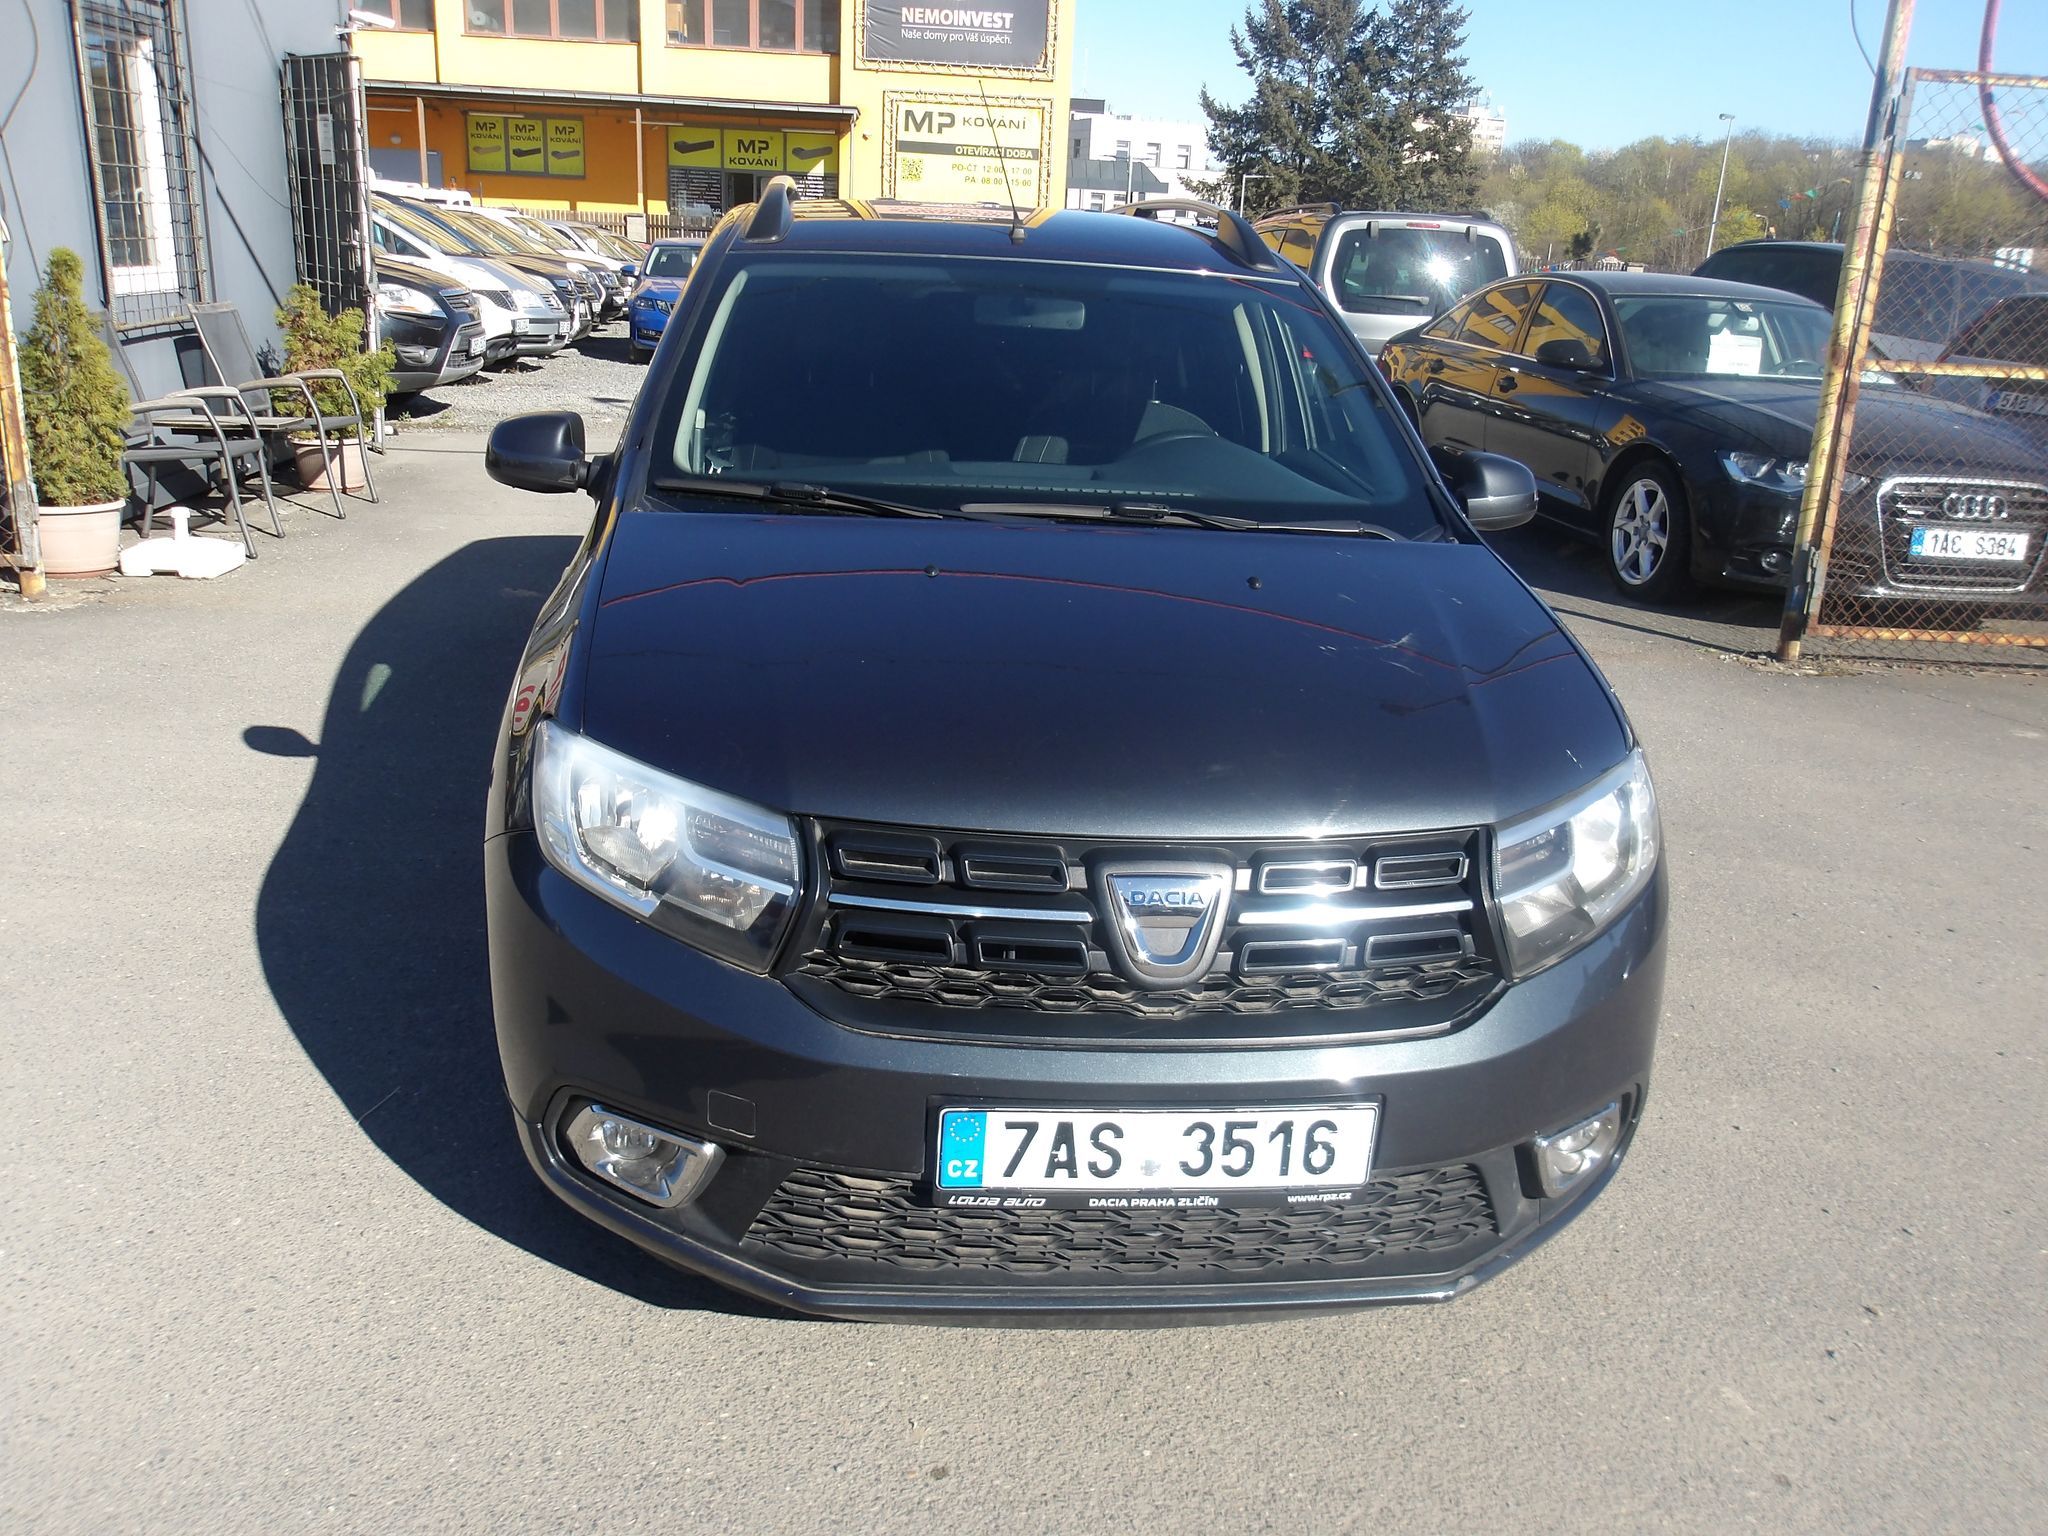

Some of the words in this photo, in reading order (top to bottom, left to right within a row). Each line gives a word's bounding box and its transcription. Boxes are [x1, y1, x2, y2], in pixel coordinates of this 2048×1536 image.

[901, 7, 1014, 29] NEMOINVEST
[901, 29, 922, 39] Naše
[923, 30, 948, 43] domy
[949, 33, 964, 43] pro
[965, 32, 979, 43] Váš
[980, 33, 1013, 45] úspěch.
[475, 121, 497, 131] MP
[904, 109, 956, 134] MP
[515, 123, 536, 133] MP
[555, 126, 576, 135] MP
[737, 138, 770, 154] MP
[1006, 149, 1033, 159] DOBA
[729, 156, 778, 167] KOVÁNÍ
[1129, 890, 1204, 905] DACIA
[947, 1159, 978, 1178] CZ
[1003, 1121, 1124, 1178] 7AS
[1179, 1120, 1338, 1177] 3516
[1089, 1197, 1128, 1207] DACIA
[1130, 1197, 1175, 1207] PRAHA
[1177, 1195, 1219, 1207] ZLIČÍN
[1287, 1192, 1352, 1203] www.rpz.cz
